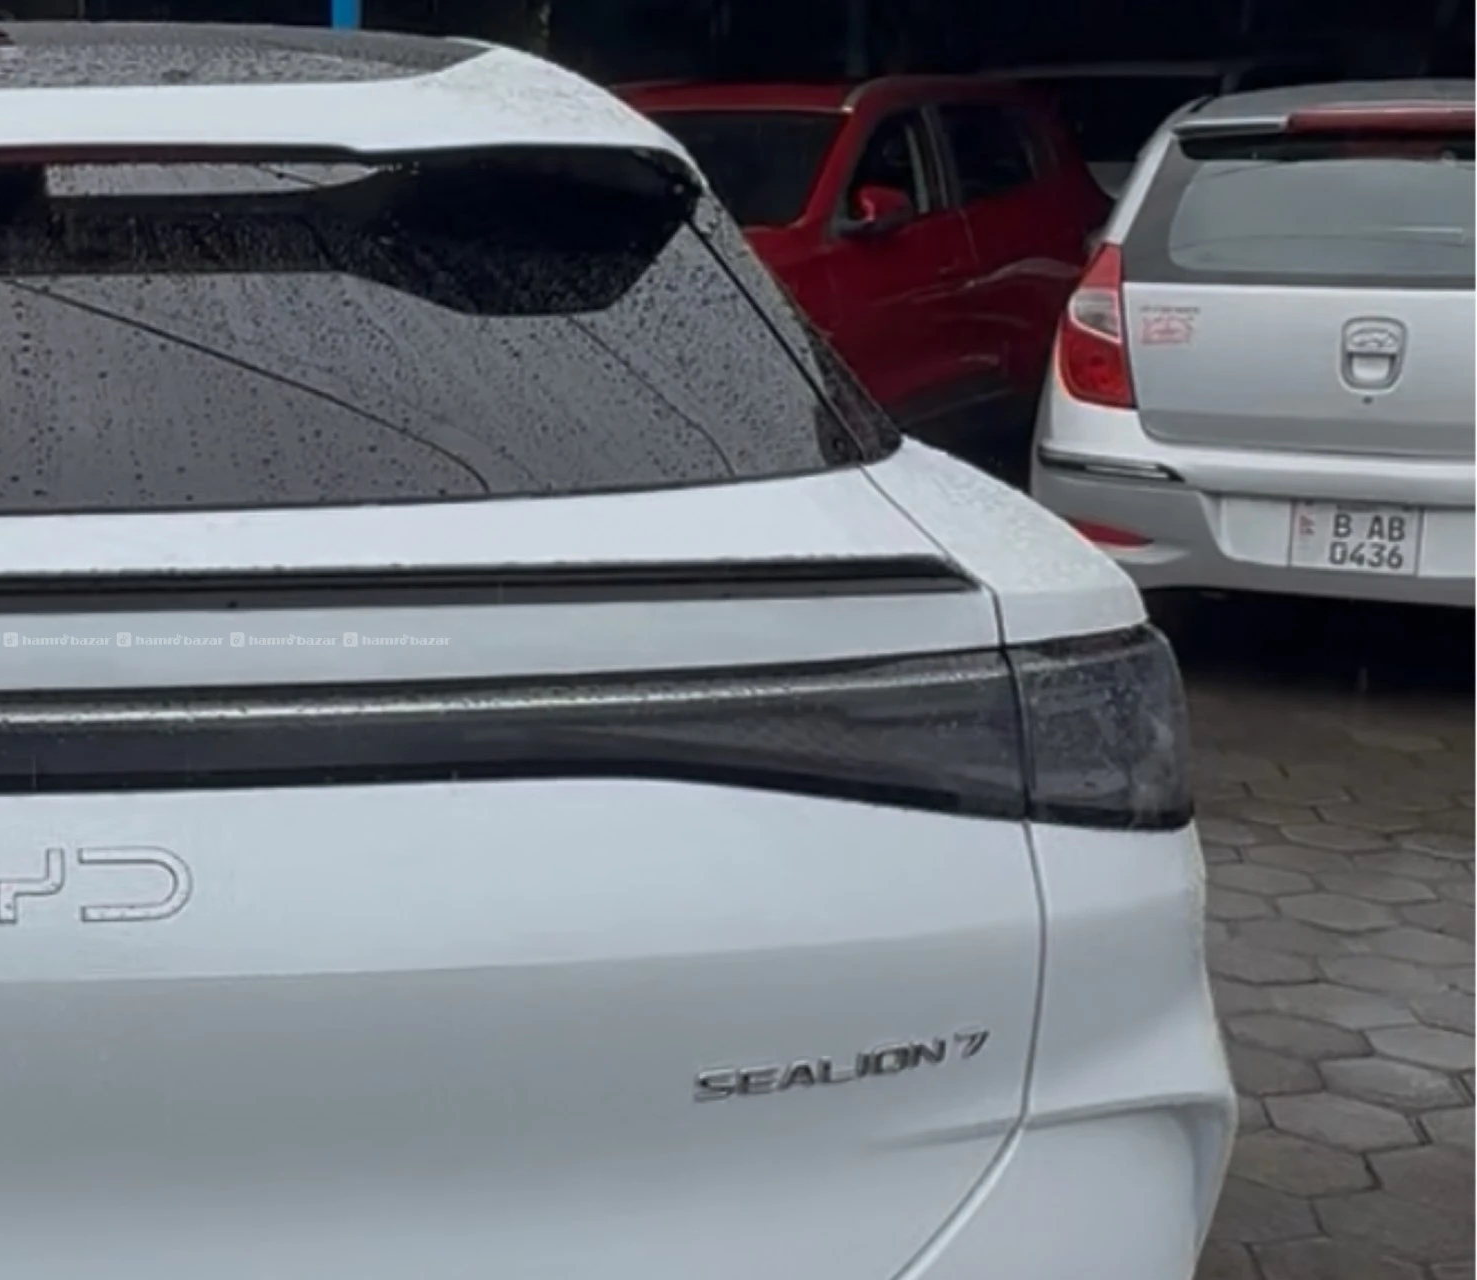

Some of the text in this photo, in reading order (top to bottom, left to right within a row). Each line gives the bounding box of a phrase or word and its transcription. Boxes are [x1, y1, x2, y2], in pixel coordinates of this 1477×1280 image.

[1334, 513, 1406, 542] B AB
[1328, 540, 1404, 569] 0436
[692, 1028, 991, 1103] SEALION 7
